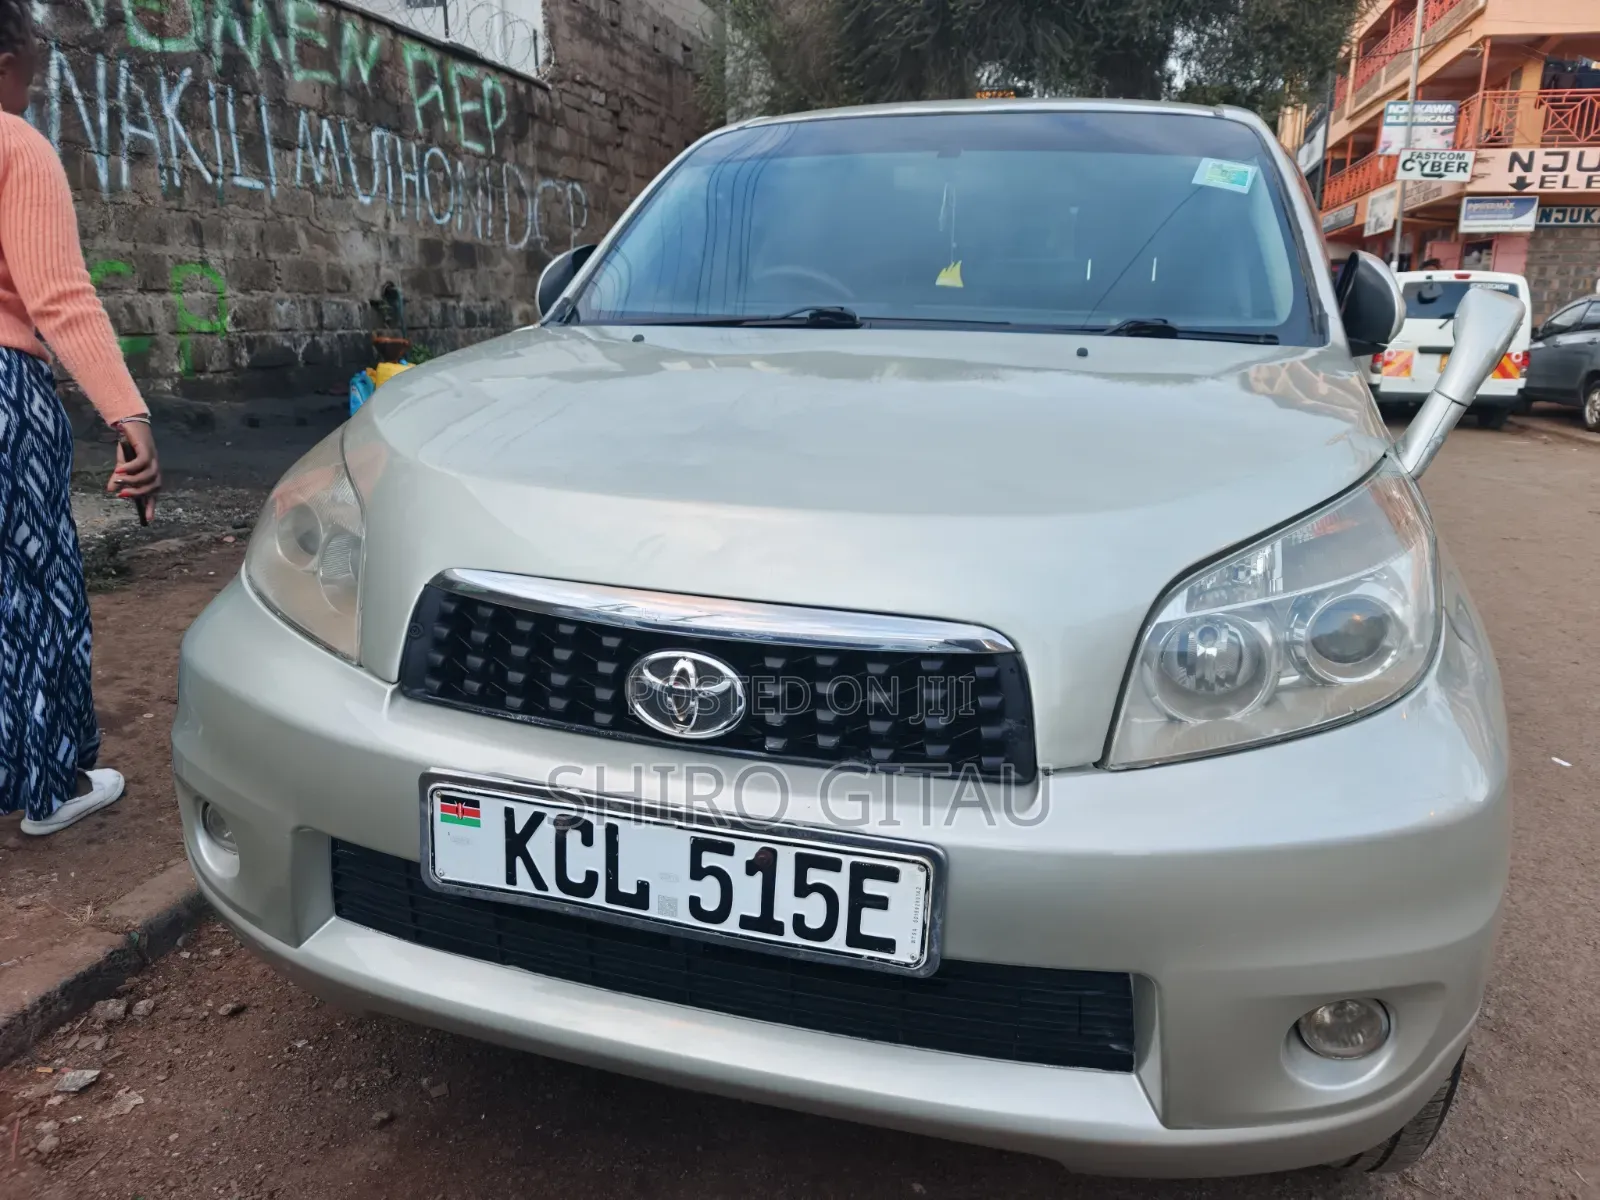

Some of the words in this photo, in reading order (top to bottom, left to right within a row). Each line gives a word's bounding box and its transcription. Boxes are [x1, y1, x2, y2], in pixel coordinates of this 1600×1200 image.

[1410, 152, 1466, 161] FASTCOM
[1401, 158, 1469, 173] CYBER
[503, 806, 650, 911] KCL
[688, 834, 901, 955] 515E
